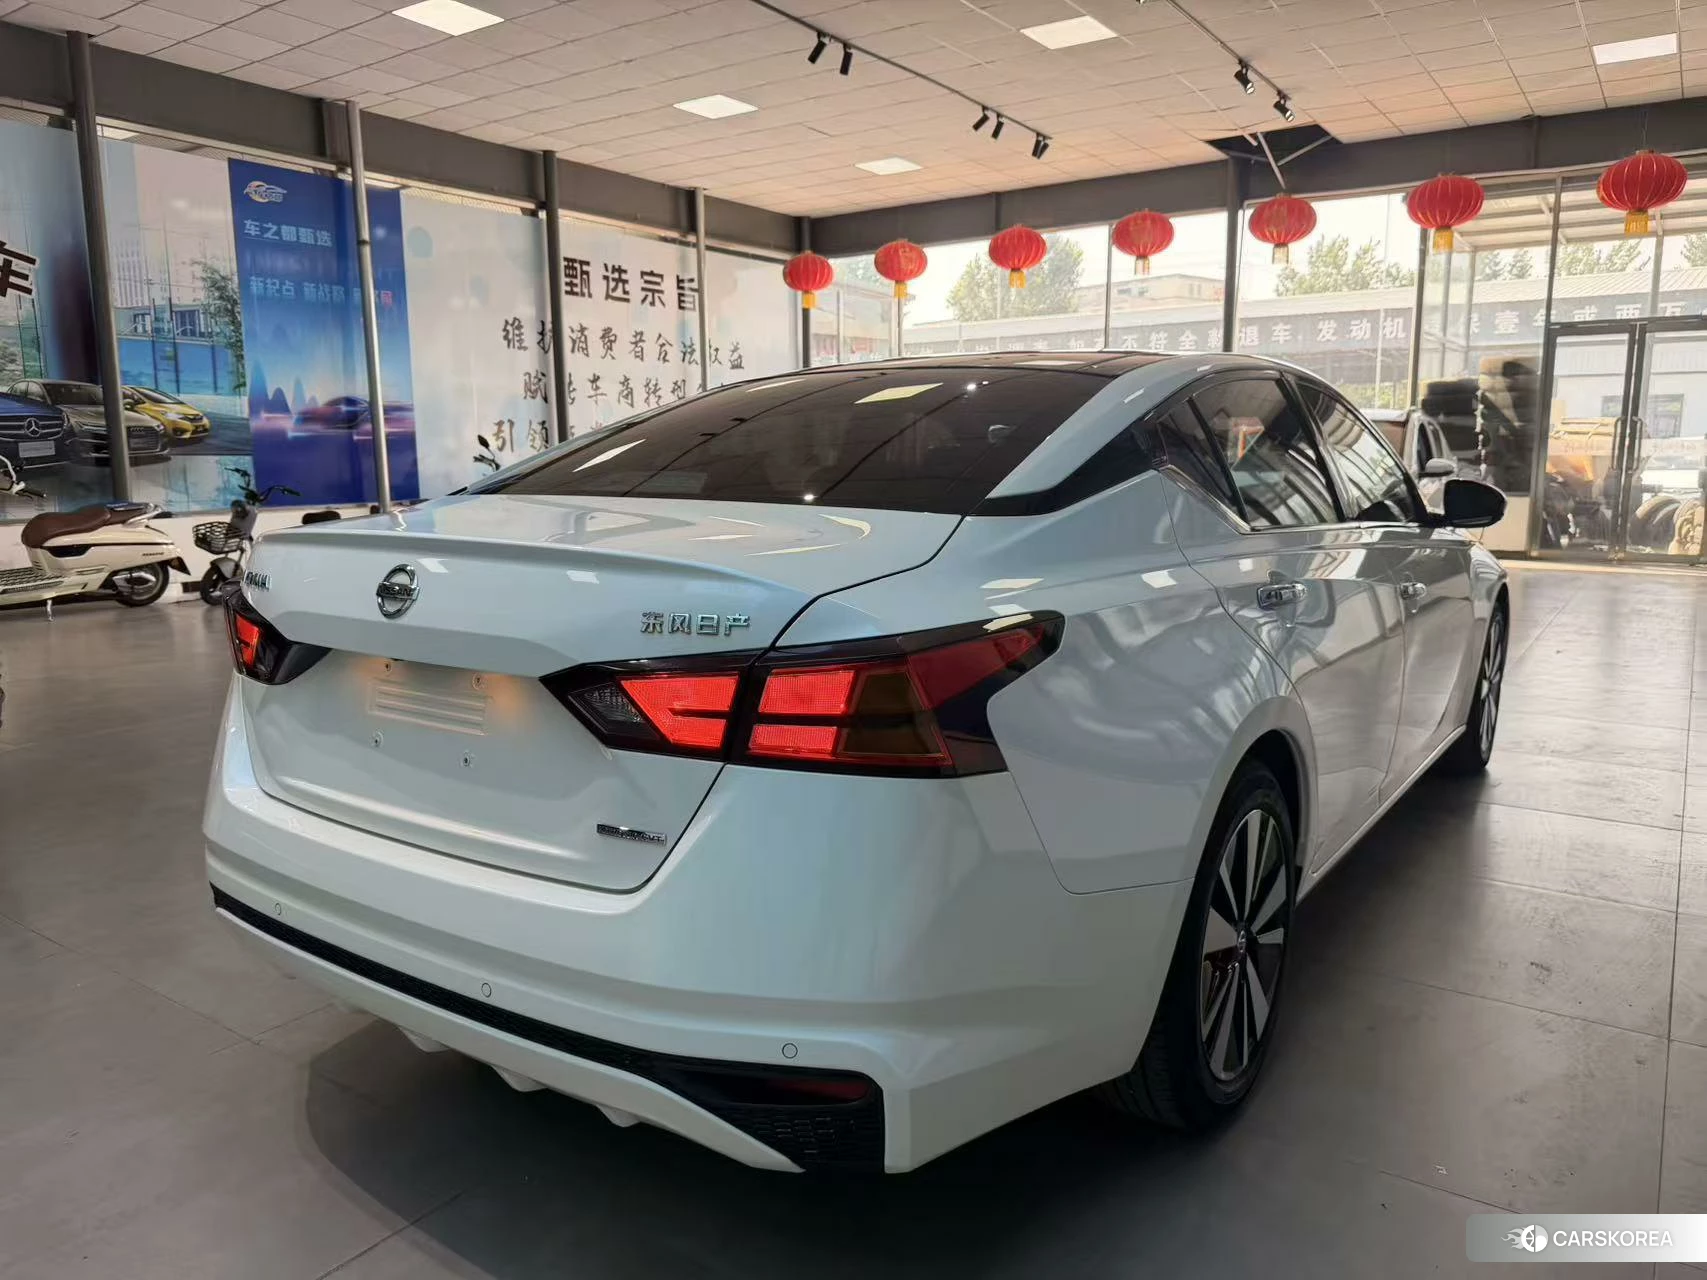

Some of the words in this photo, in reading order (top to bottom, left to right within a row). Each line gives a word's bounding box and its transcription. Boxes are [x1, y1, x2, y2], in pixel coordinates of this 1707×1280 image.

[563, 256, 699, 312] 甄选宗旨
[640, 611, 751, 636] 东风日产
